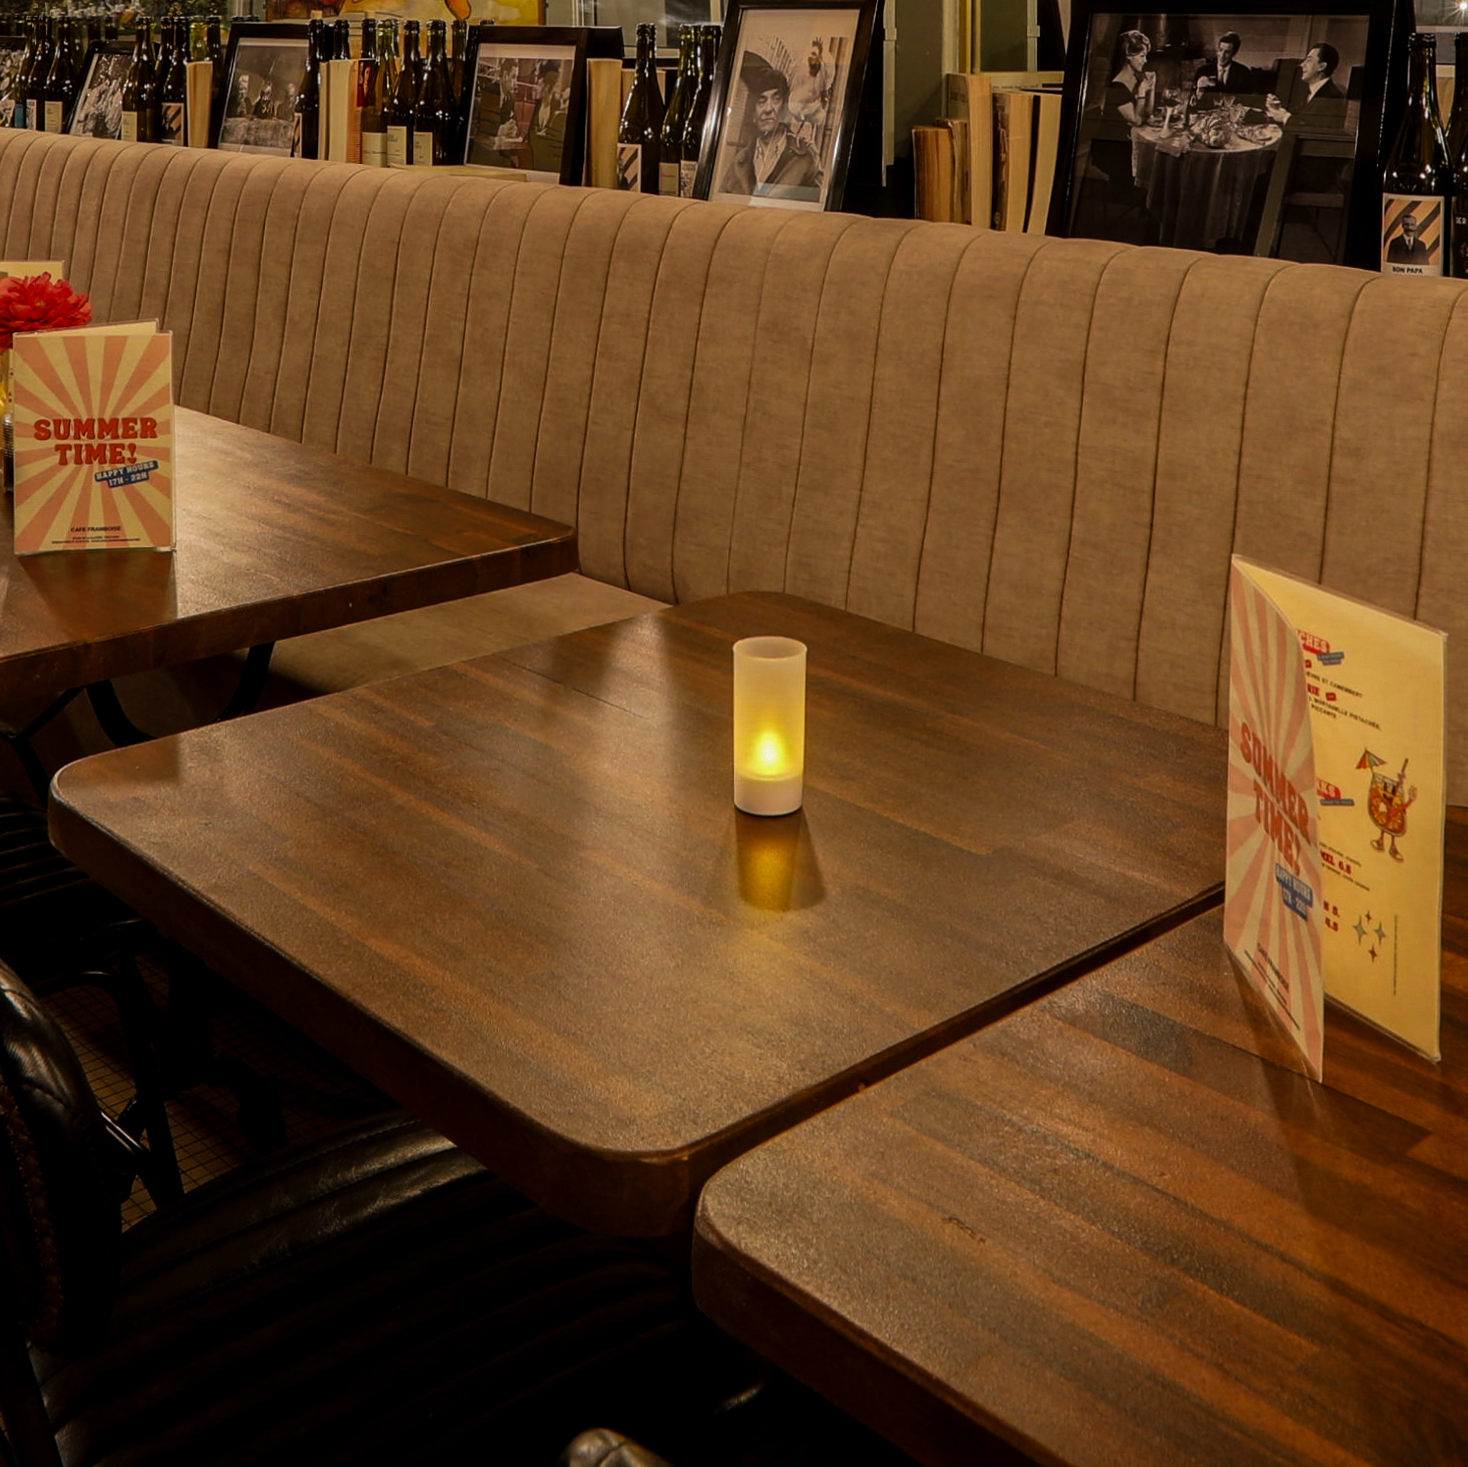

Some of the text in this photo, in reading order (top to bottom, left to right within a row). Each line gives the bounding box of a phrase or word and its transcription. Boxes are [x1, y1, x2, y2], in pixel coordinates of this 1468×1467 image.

[1406, 266, 1423, 275] PAPA
[34, 417, 158, 441] SUMMER
[54, 442, 137, 466] TIME!
[96, 461, 155, 480] HAPPY HOURS
[108, 476, 124, 487] 17H
[130, 472, 148, 483] 22H
[1240, 722, 1312, 847] SUMMER
[1253, 779, 1301, 877] TIME!
